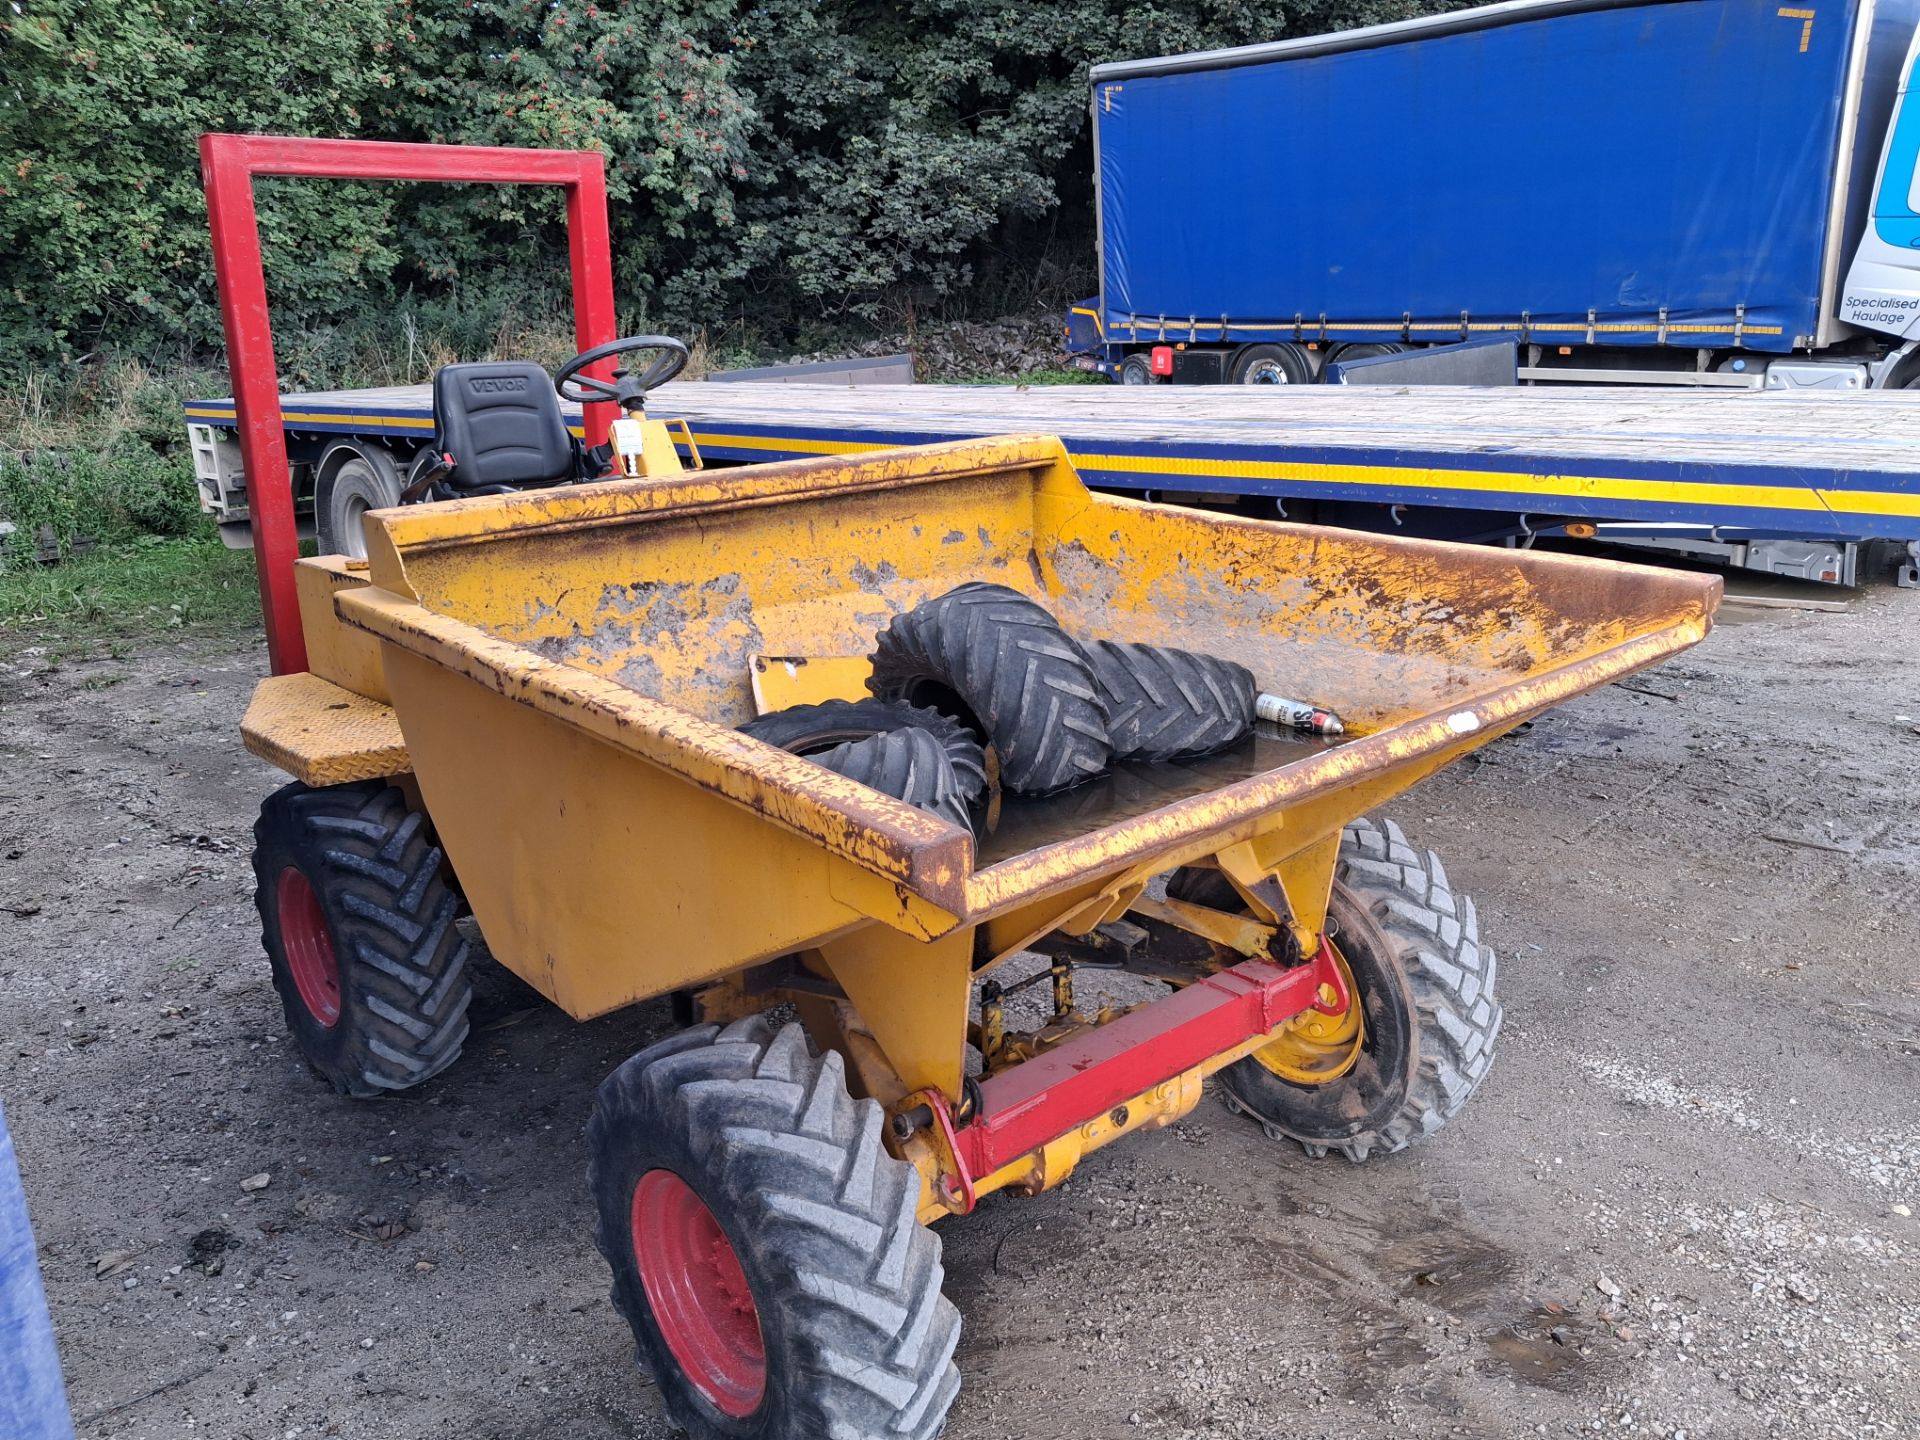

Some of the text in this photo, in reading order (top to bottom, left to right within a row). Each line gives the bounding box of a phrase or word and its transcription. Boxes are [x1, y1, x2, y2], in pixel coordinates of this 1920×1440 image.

[1845, 296, 1919, 309] Specialised
[1852, 311, 1905, 324] Haulage
[471, 380, 526, 393] VEVOR
